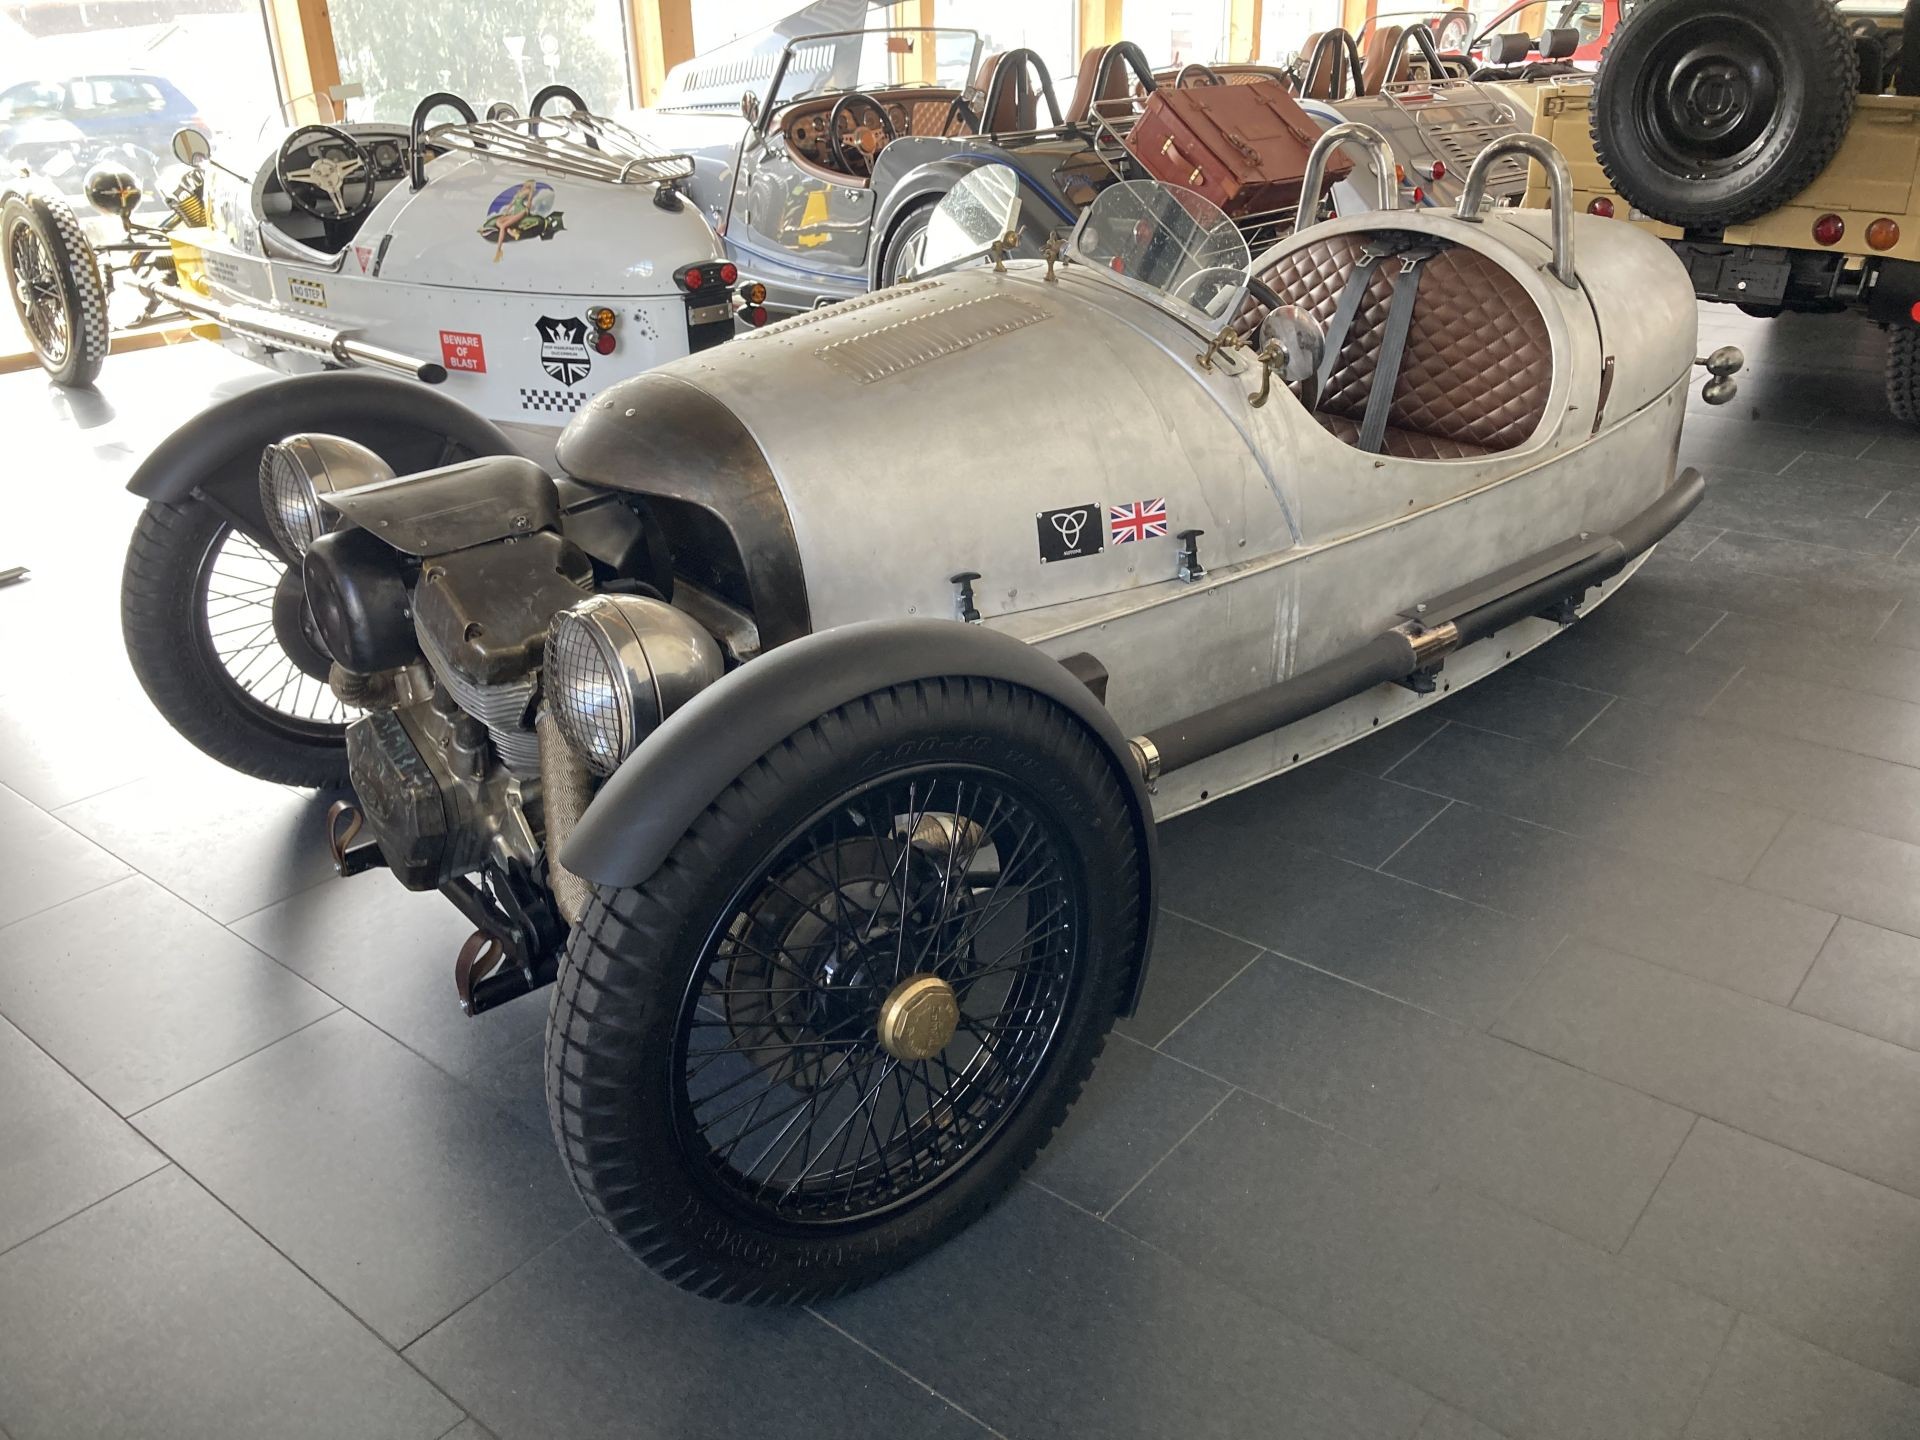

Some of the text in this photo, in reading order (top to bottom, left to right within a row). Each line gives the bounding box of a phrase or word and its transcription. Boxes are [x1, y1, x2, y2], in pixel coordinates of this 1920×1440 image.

[294, 286, 320, 299] NO STEP
[442, 334, 480, 347] BEWARE
[456, 346, 469, 357] OF
[450, 356, 478, 369] BLAST
